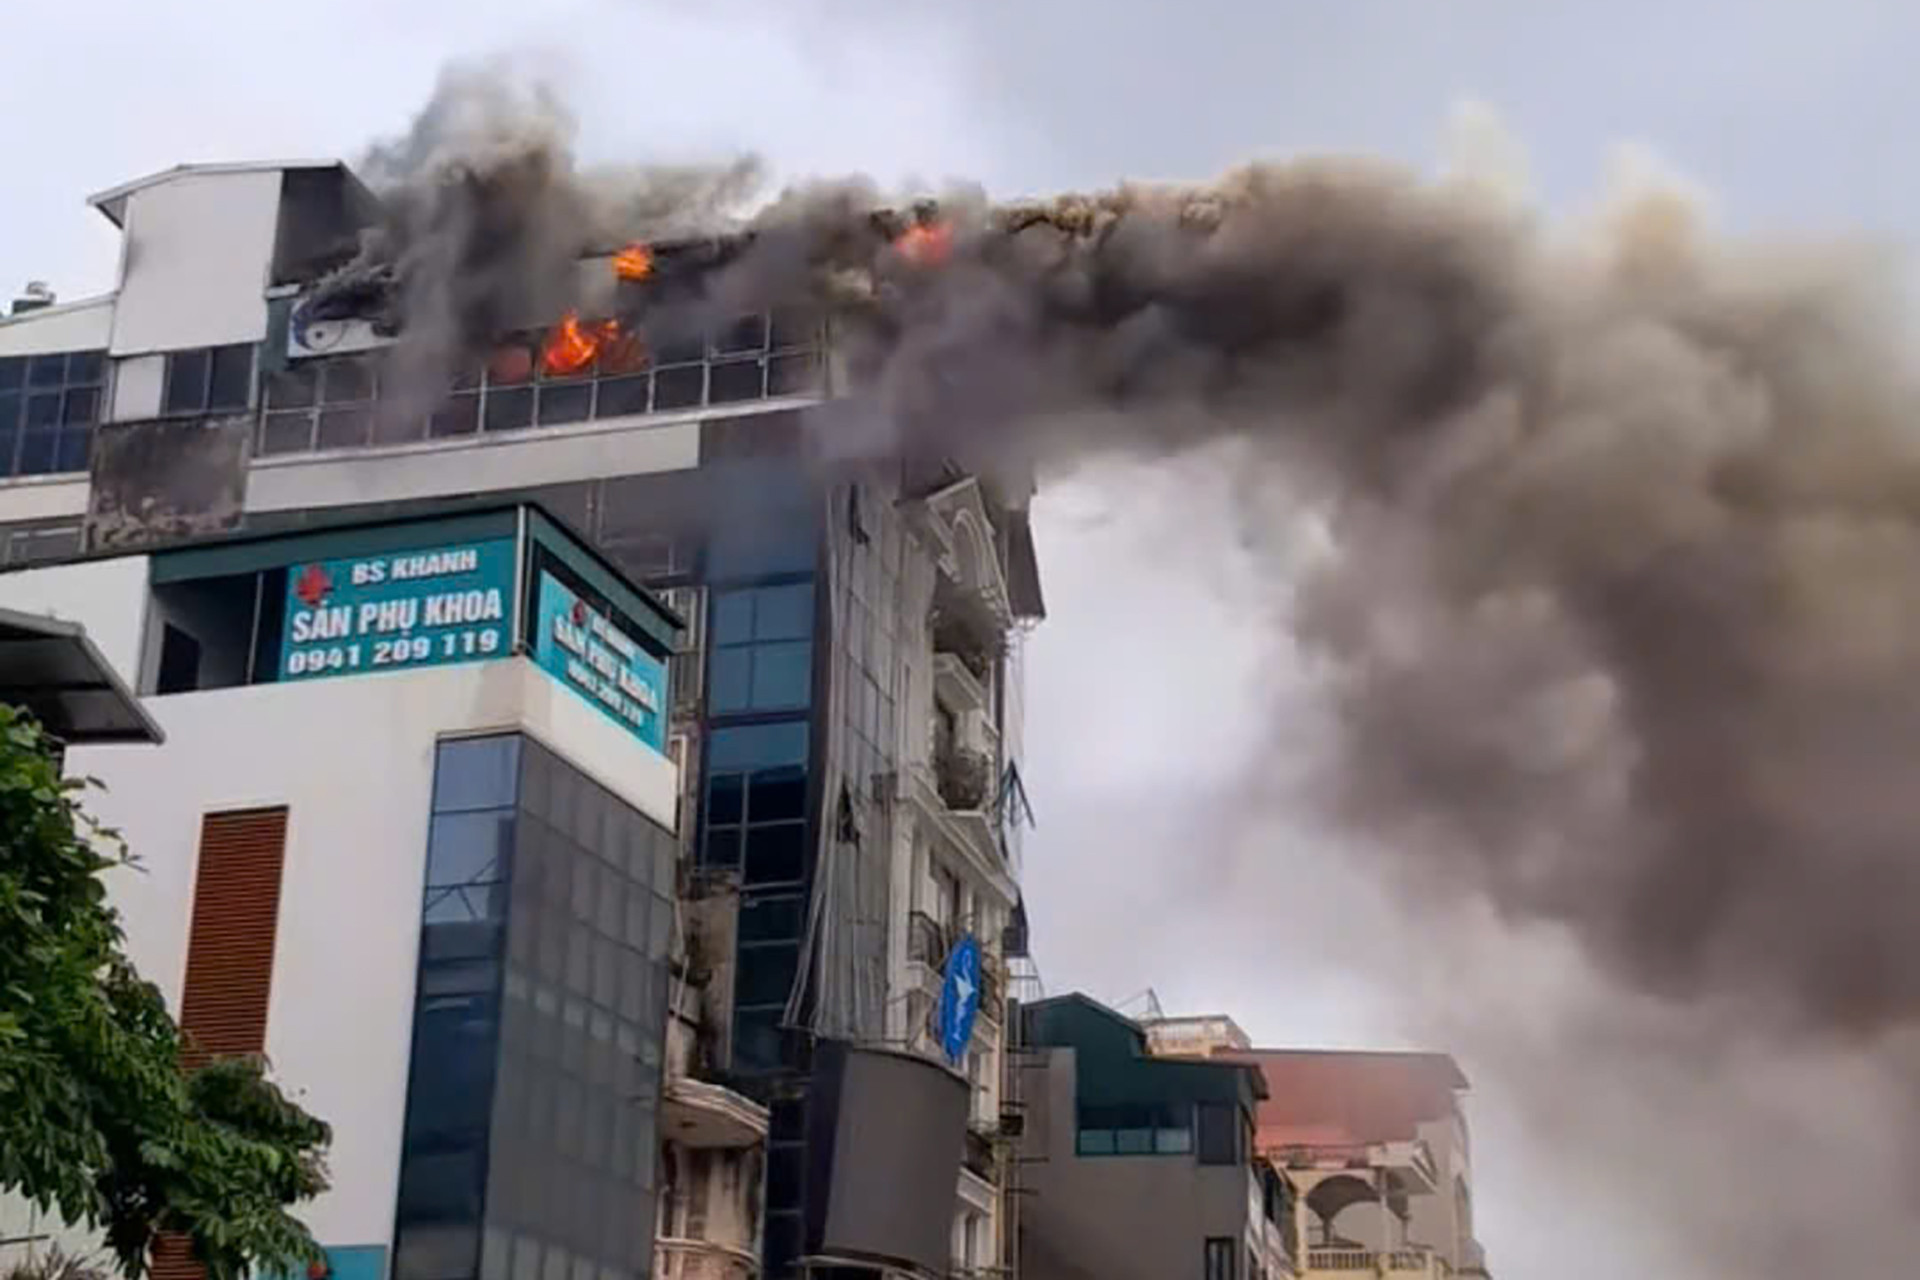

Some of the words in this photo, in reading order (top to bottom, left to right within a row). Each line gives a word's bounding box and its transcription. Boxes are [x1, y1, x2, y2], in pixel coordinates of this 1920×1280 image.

[352, 560, 385, 585] BS
[358, 598, 418, 637] PHỤ
[423, 588, 503, 626] KHOA
[288, 645, 361, 674] 0941
[373, 637, 431, 664] 209
[442, 629, 499, 655] 119
